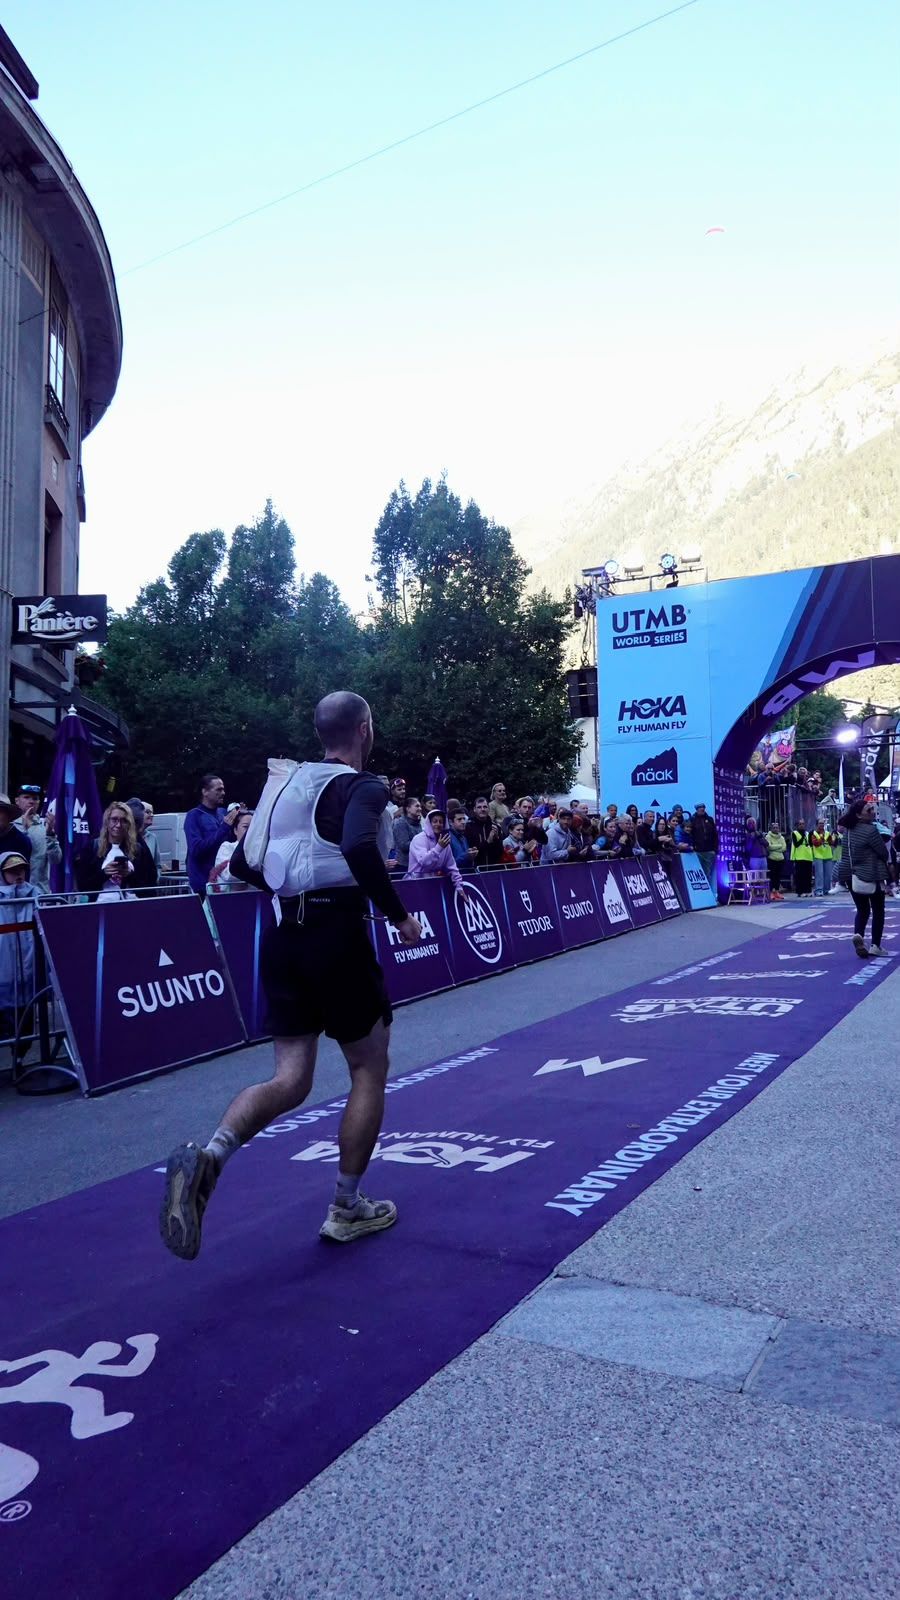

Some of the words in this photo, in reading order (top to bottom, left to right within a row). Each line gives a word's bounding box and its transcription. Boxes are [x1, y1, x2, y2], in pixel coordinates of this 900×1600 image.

[17, 600, 99, 632] Panière
[612, 604, 687, 633] UTMB
[615, 635, 651, 647] WORLD
[654, 632, 685, 644] SERIES
[617, 695, 687, 721] HOKA
[618, 725, 632, 734] FLY
[634, 722, 670, 732] HUMAN
[671, 720, 687, 730] FLY
[636, 768, 674, 783] näak
[562, 900, 594, 920] SUUNTO
[384, 911, 435, 946] HA
[518, 915, 554, 937] TUDOR
[394, 951, 406, 964] FLY
[405, 946, 431, 960] HUMAN
[117, 969, 225, 1018] SUUNTO
[734, 1052, 780, 1073] MEET
[697, 1074, 757, 1100] YOUR
[382, 1131, 499, 1143] HUMAN
[496, 1138, 555, 1149] FLY
[544, 1100, 723, 1217] EXTRAORDINARY
